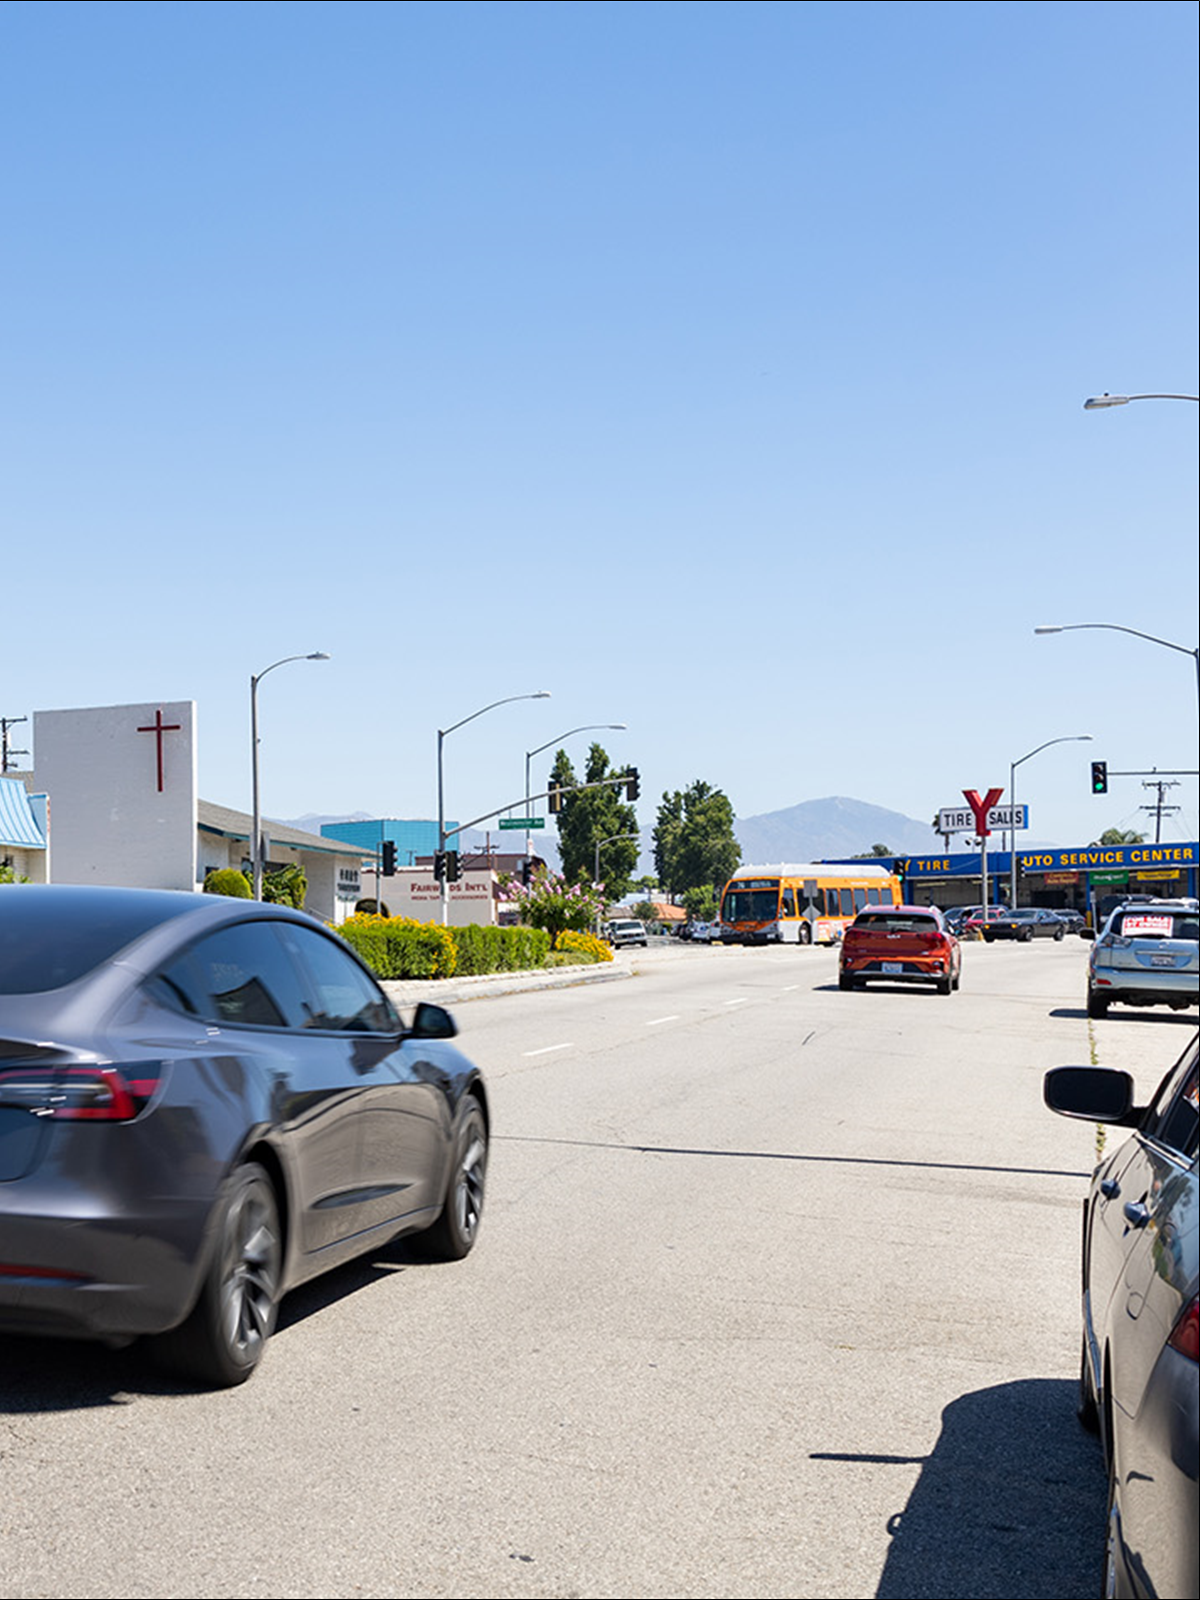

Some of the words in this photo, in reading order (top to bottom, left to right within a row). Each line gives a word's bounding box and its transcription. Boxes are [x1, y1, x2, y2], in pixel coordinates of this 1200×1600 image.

[944, 813, 972, 827] TIRE
[961, 787, 1005, 837] Y
[917, 860, 950, 871] TIRE
[1023, 855, 1054, 867] UTO
[1060, 851, 1124, 865] SERVICE
[1131, 848, 1193, 862] CENTER
